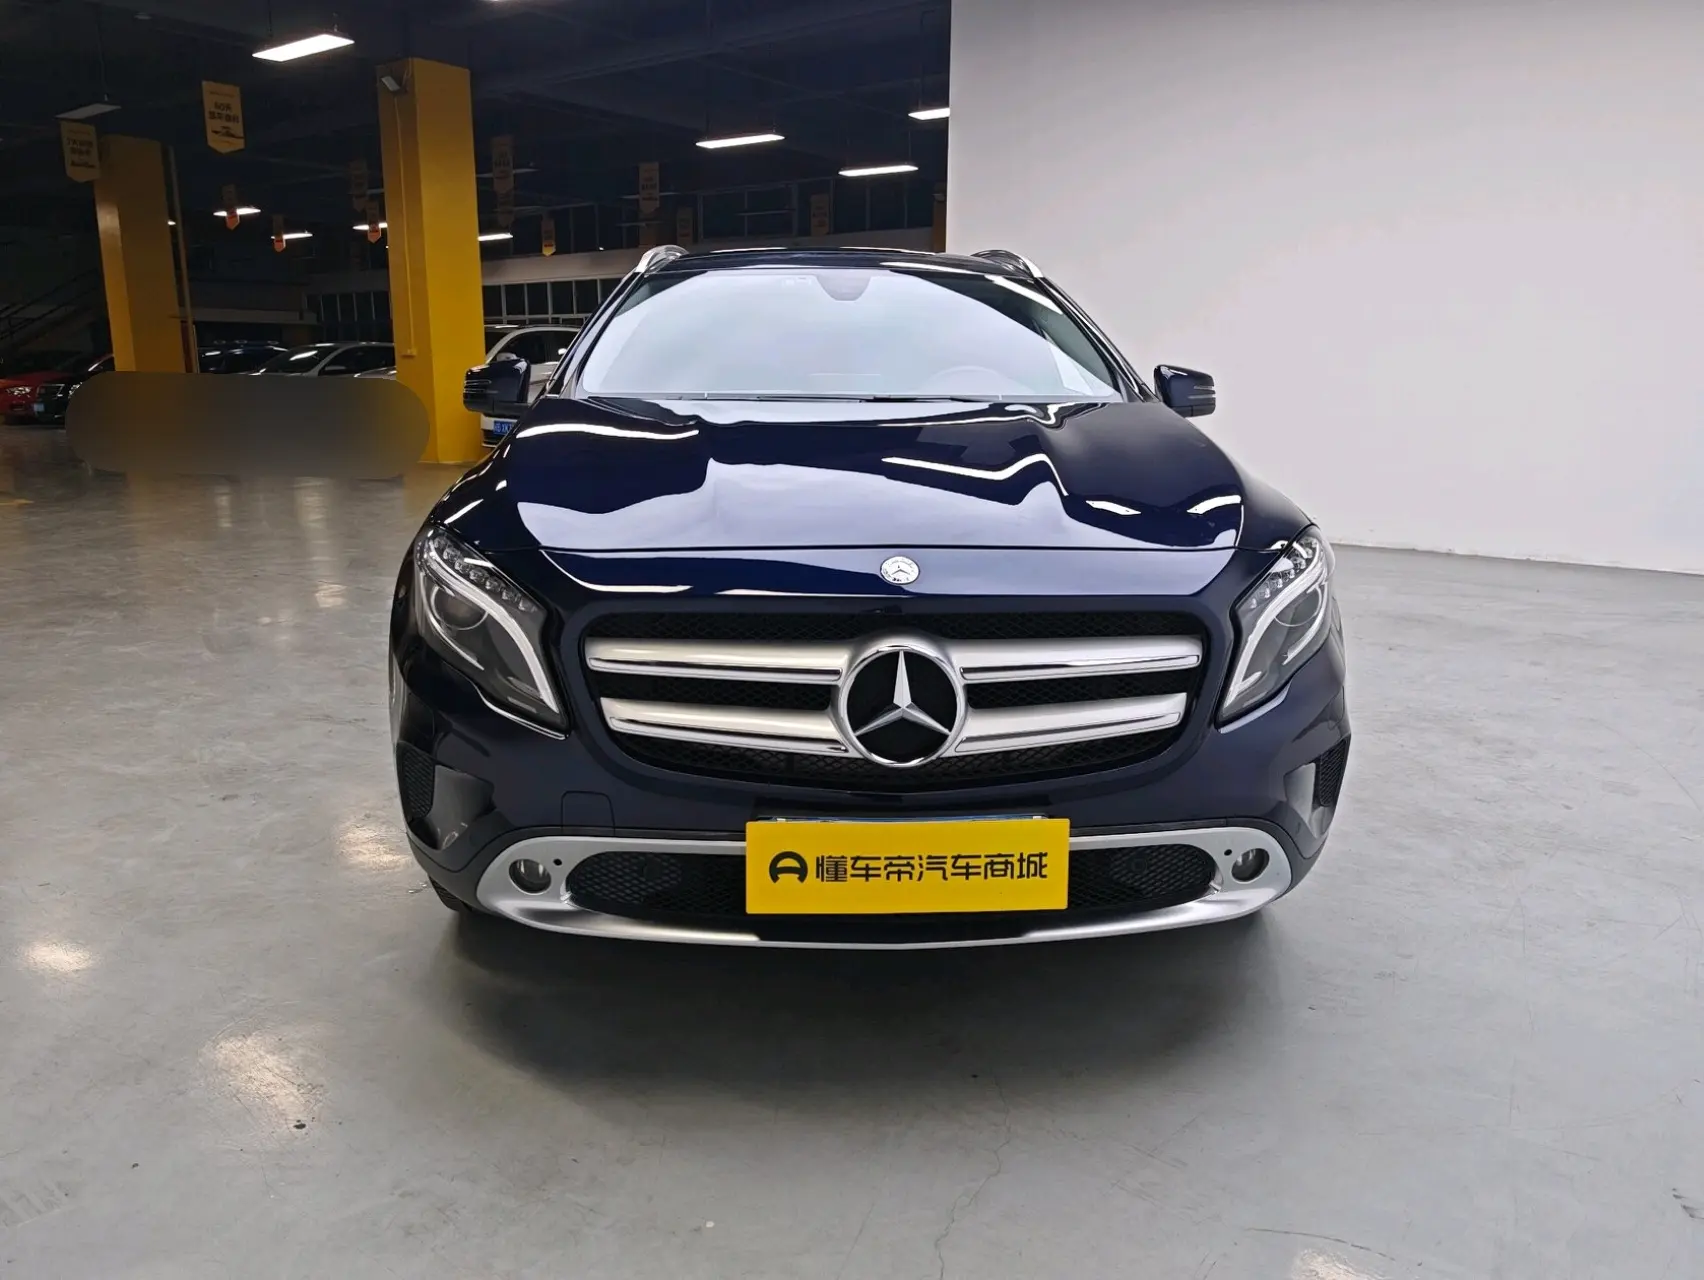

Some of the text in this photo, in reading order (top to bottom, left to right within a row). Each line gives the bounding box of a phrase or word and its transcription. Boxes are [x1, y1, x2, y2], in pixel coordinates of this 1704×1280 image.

[815, 851, 1048, 883] 懂车帝汽车商城
